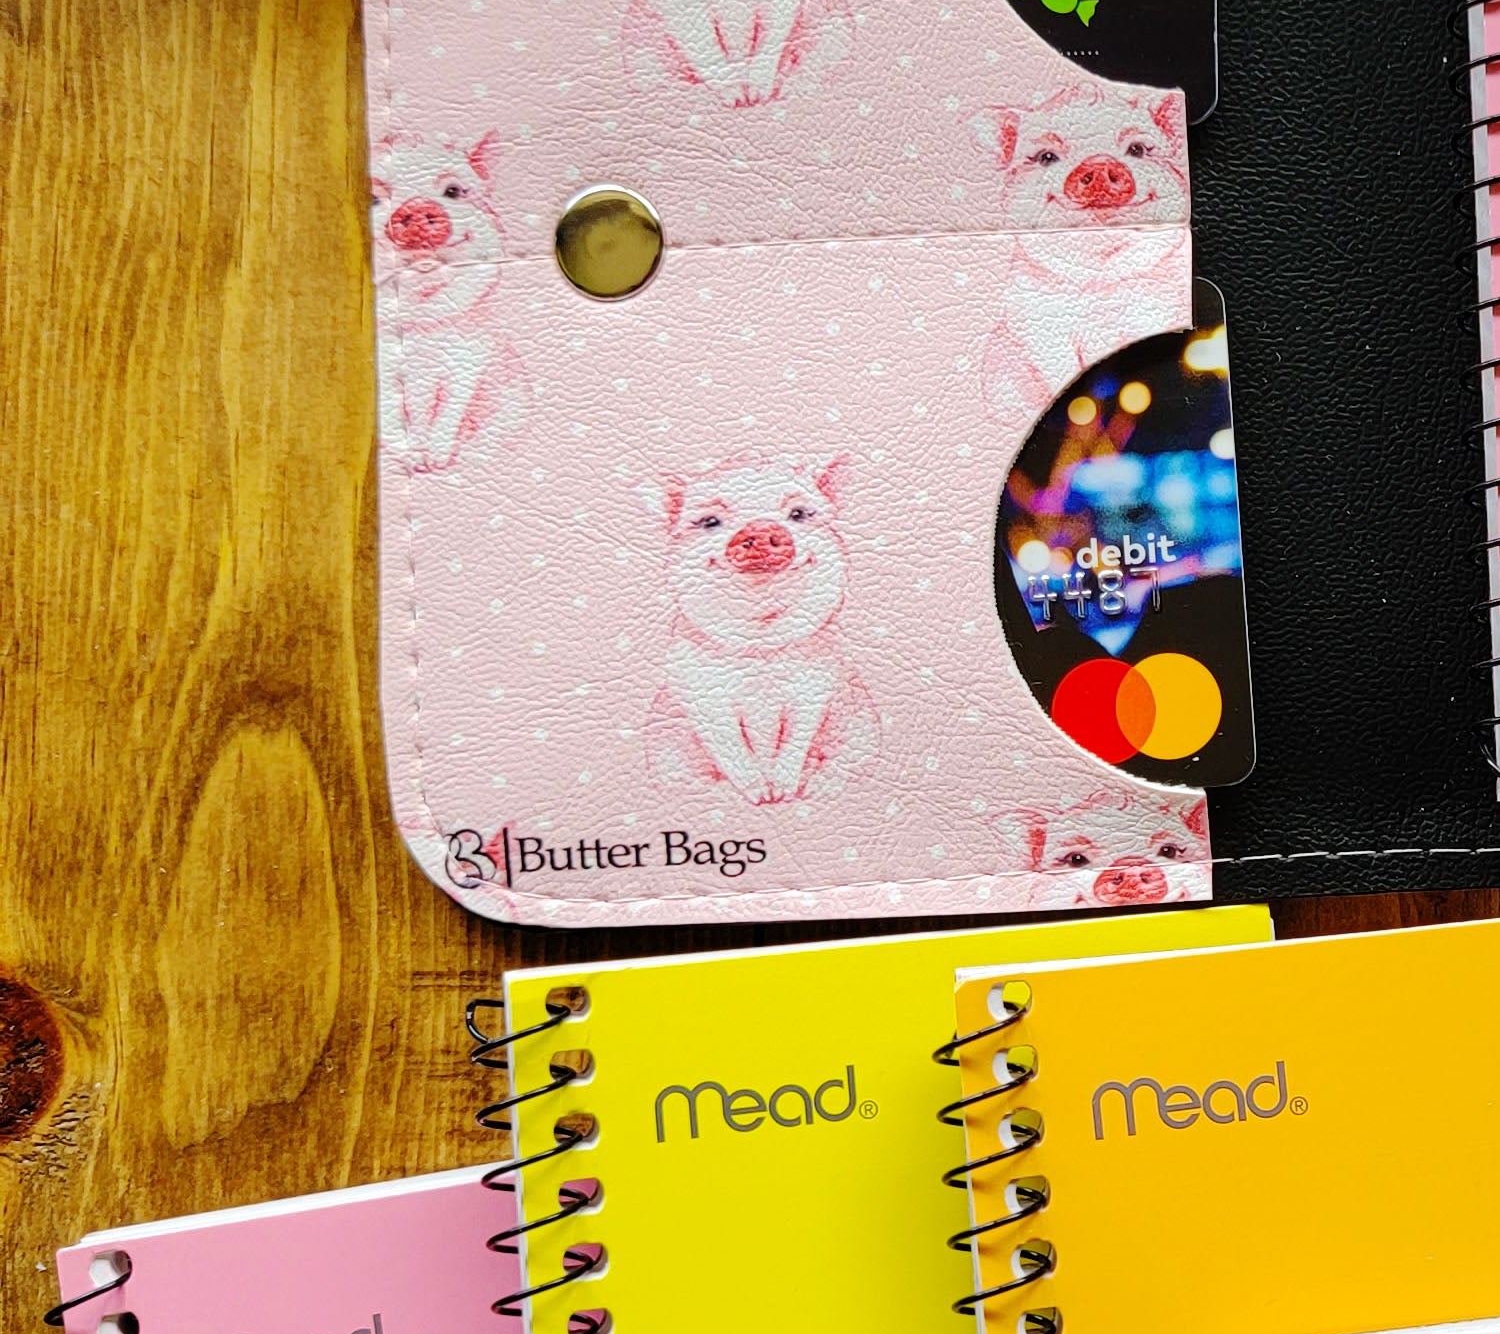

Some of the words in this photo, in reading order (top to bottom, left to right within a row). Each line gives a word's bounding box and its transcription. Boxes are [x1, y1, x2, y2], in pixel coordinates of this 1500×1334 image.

[1075, 532, 1177, 570] debit
[1028, 567, 1163, 622] 4487
[517, 836, 650, 873] Butter
[661, 830, 768, 877] Bags
